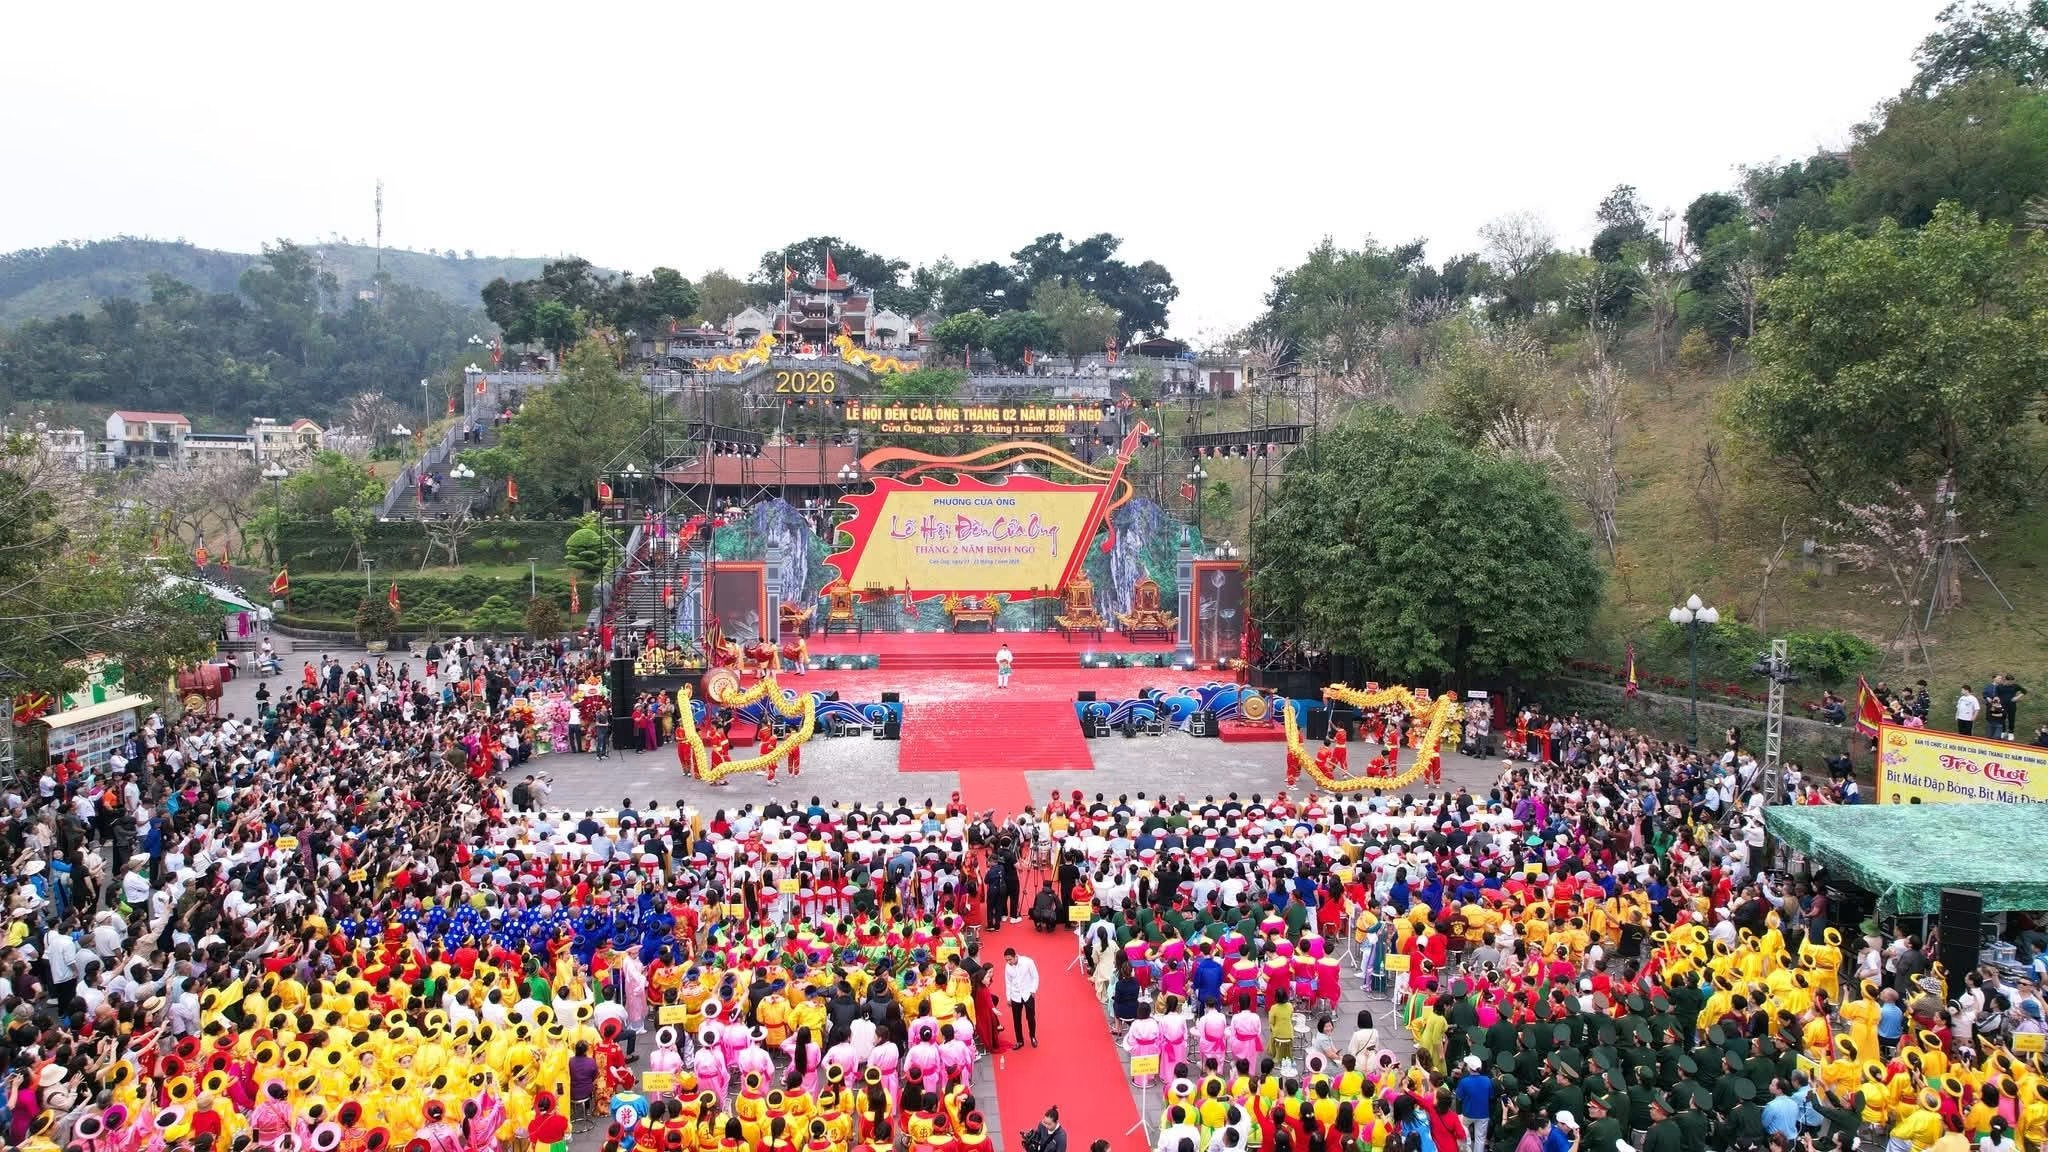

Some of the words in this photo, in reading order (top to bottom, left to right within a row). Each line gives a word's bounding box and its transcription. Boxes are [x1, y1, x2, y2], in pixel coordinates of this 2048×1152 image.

[776, 371, 835, 393] 2026
[846, 400, 860, 420] LỄ
[863, 404, 881, 424] HỘI
[885, 400, 907, 420] ĐỀN
[910, 403, 933, 420] CỬA
[936, 404, 959, 420] ÔNG
[963, 404, 999, 420] THÁNG
[1002, 408, 1016, 420] 02
[1020, 404, 1046, 420] NĂM
[881, 422, 900, 432] Cửa
[903, 420, 925, 434] Ông,
[928, 422, 951, 433] ngày
[953, 424, 964, 432] 21
[972, 424, 983, 432] 22
[986, 422, 1012, 433] tháng
[1014, 424, 1020, 432] 3
[1022, 422, 1042, 432] năm
[890, 514, 916, 539] Lễ
[921, 514, 951, 544] Hội
[954, 513, 991, 541] Đền
[992, 516, 1025, 541] Cửa
[1027, 513, 1061, 557] Ông
[952, 546, 958, 554] 2
[1939, 754, 1981, 774] Trò
[1983, 761, 2030, 789] Chơi
[1902, 772, 1922, 787] Mắt
[1923, 776, 1945, 793] Đập
[1947, 780, 1977, 798] Bóng,
